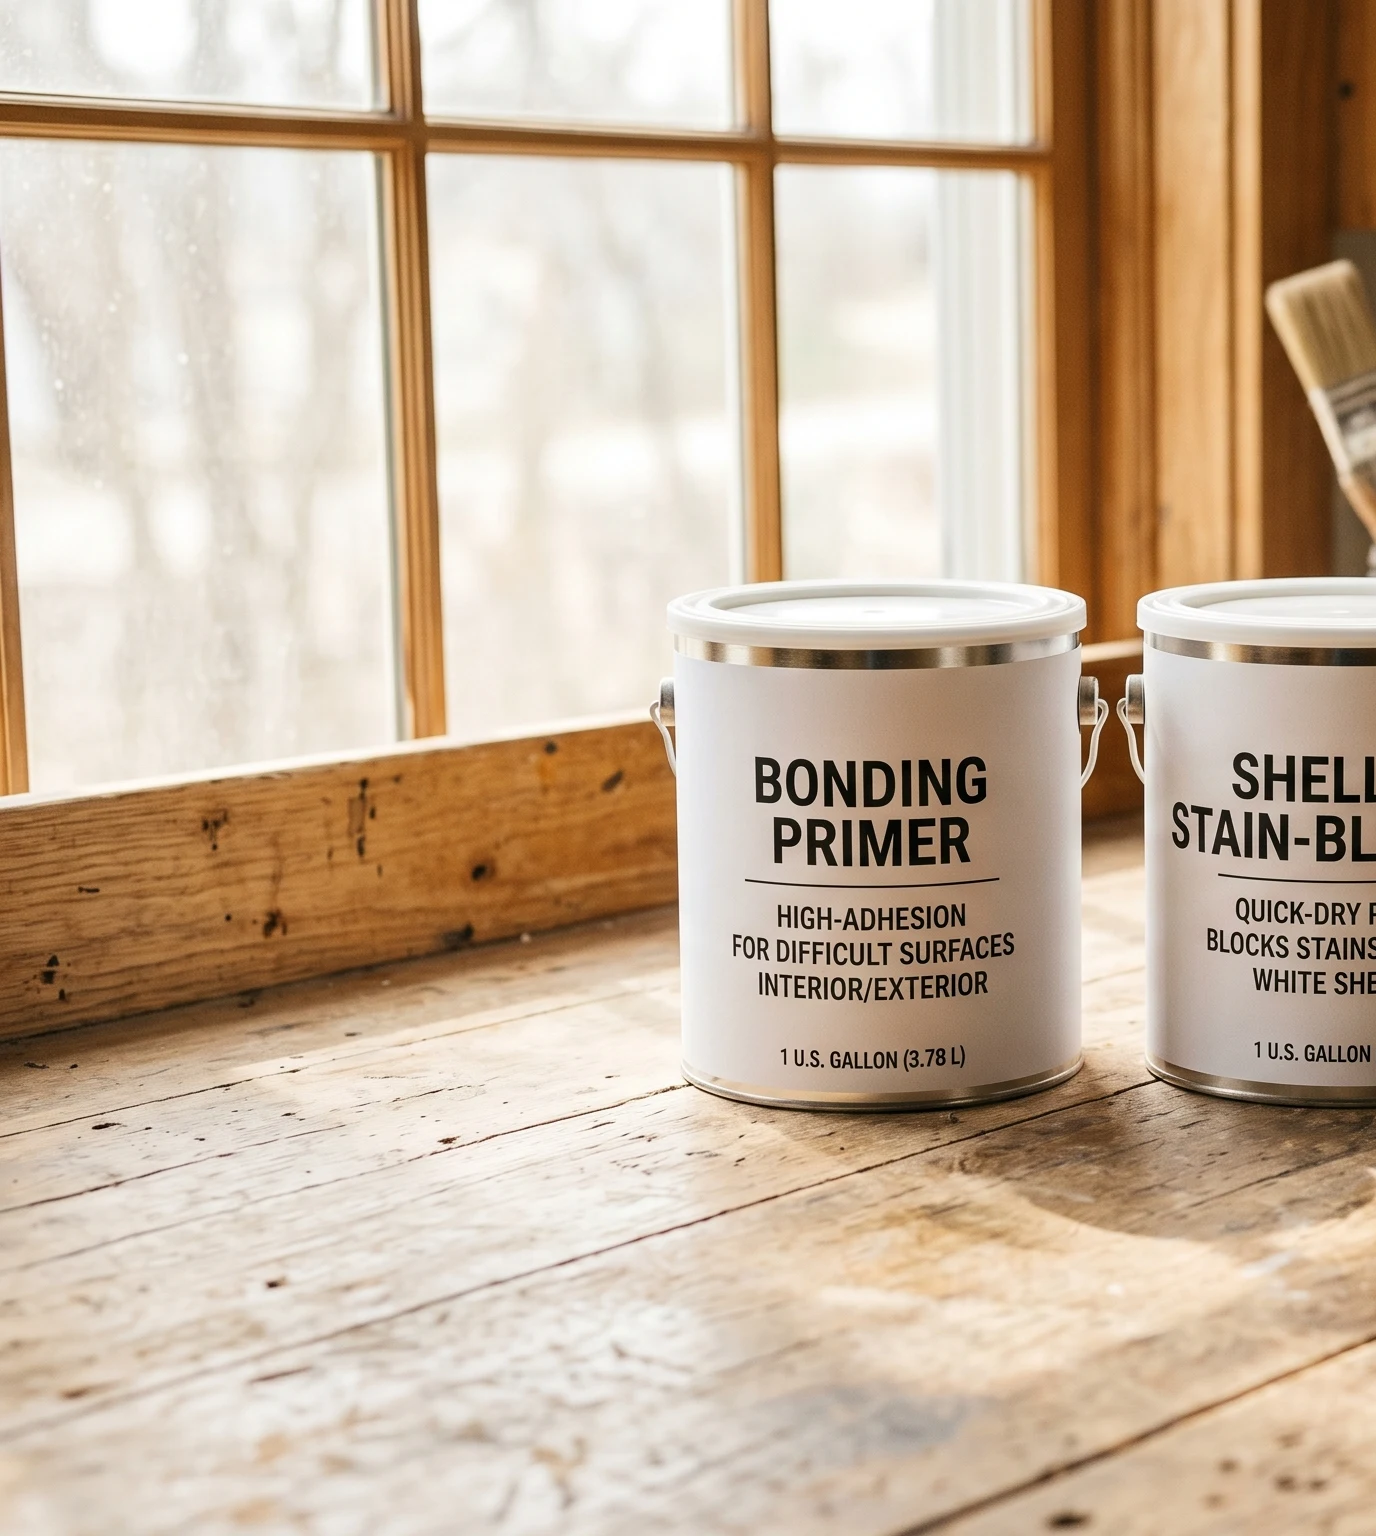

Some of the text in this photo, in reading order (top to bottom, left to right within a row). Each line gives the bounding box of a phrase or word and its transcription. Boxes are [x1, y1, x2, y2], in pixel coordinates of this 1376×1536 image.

[755, 756, 987, 807] BONDING
[774, 816, 971, 867] PRIMER
[777, 903, 966, 931] HIGH-ADHESION
[1235, 898, 1361, 925] QUICK-DRY
[732, 932, 1015, 966] FOR DIFFICULT SURFACES
[1206, 928, 1290, 958] BLOCKS
[758, 970, 989, 1003] INTERIOR/EXTERIOR
[1252, 968, 1327, 994] WHITE
[780, 1045, 966, 1072] 1 U.S. GALLON (3.78 L)
[1253, 1041, 1262, 1059] 1
[1267, 1042, 1299, 1062] U.S.
[1304, 1044, 1371, 1063] GALLON
